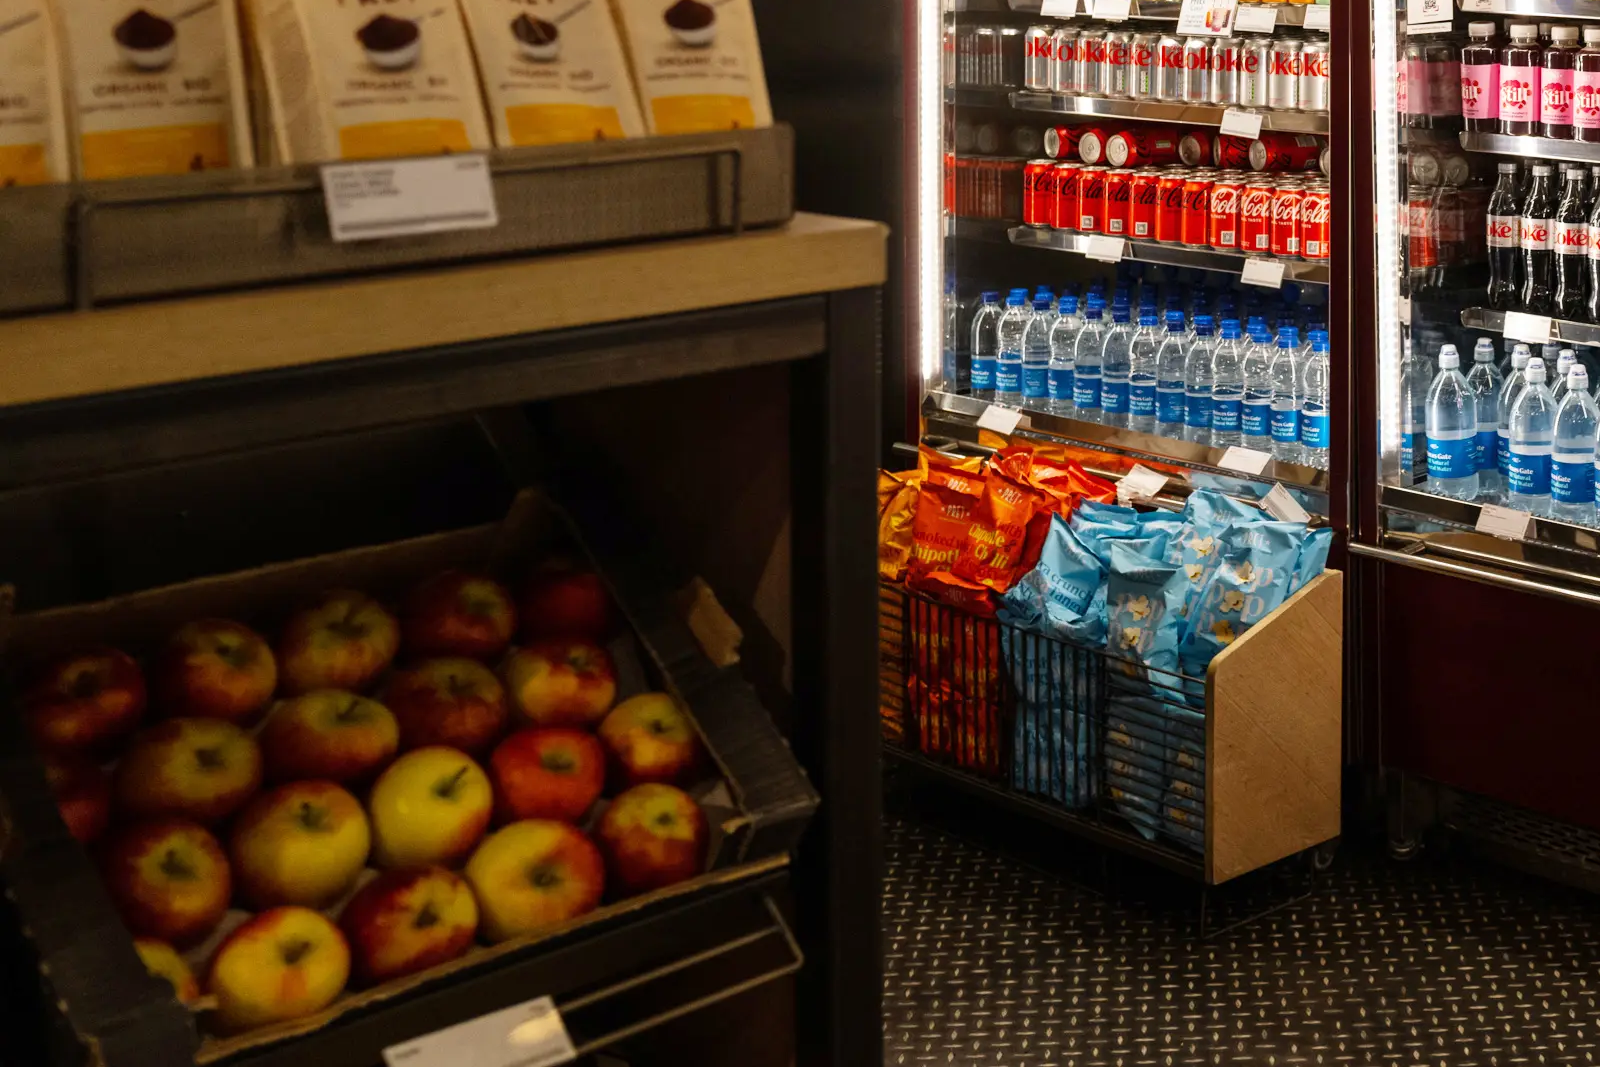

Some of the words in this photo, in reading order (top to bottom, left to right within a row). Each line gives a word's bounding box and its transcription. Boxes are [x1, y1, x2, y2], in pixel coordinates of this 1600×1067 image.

[1500, 86, 1526, 103] Still
[1543, 89, 1569, 106] Still
[1574, 92, 1600, 109] Still
[1437, 453, 1452, 461] Gate
[1003, 488, 1021, 504] PRET
